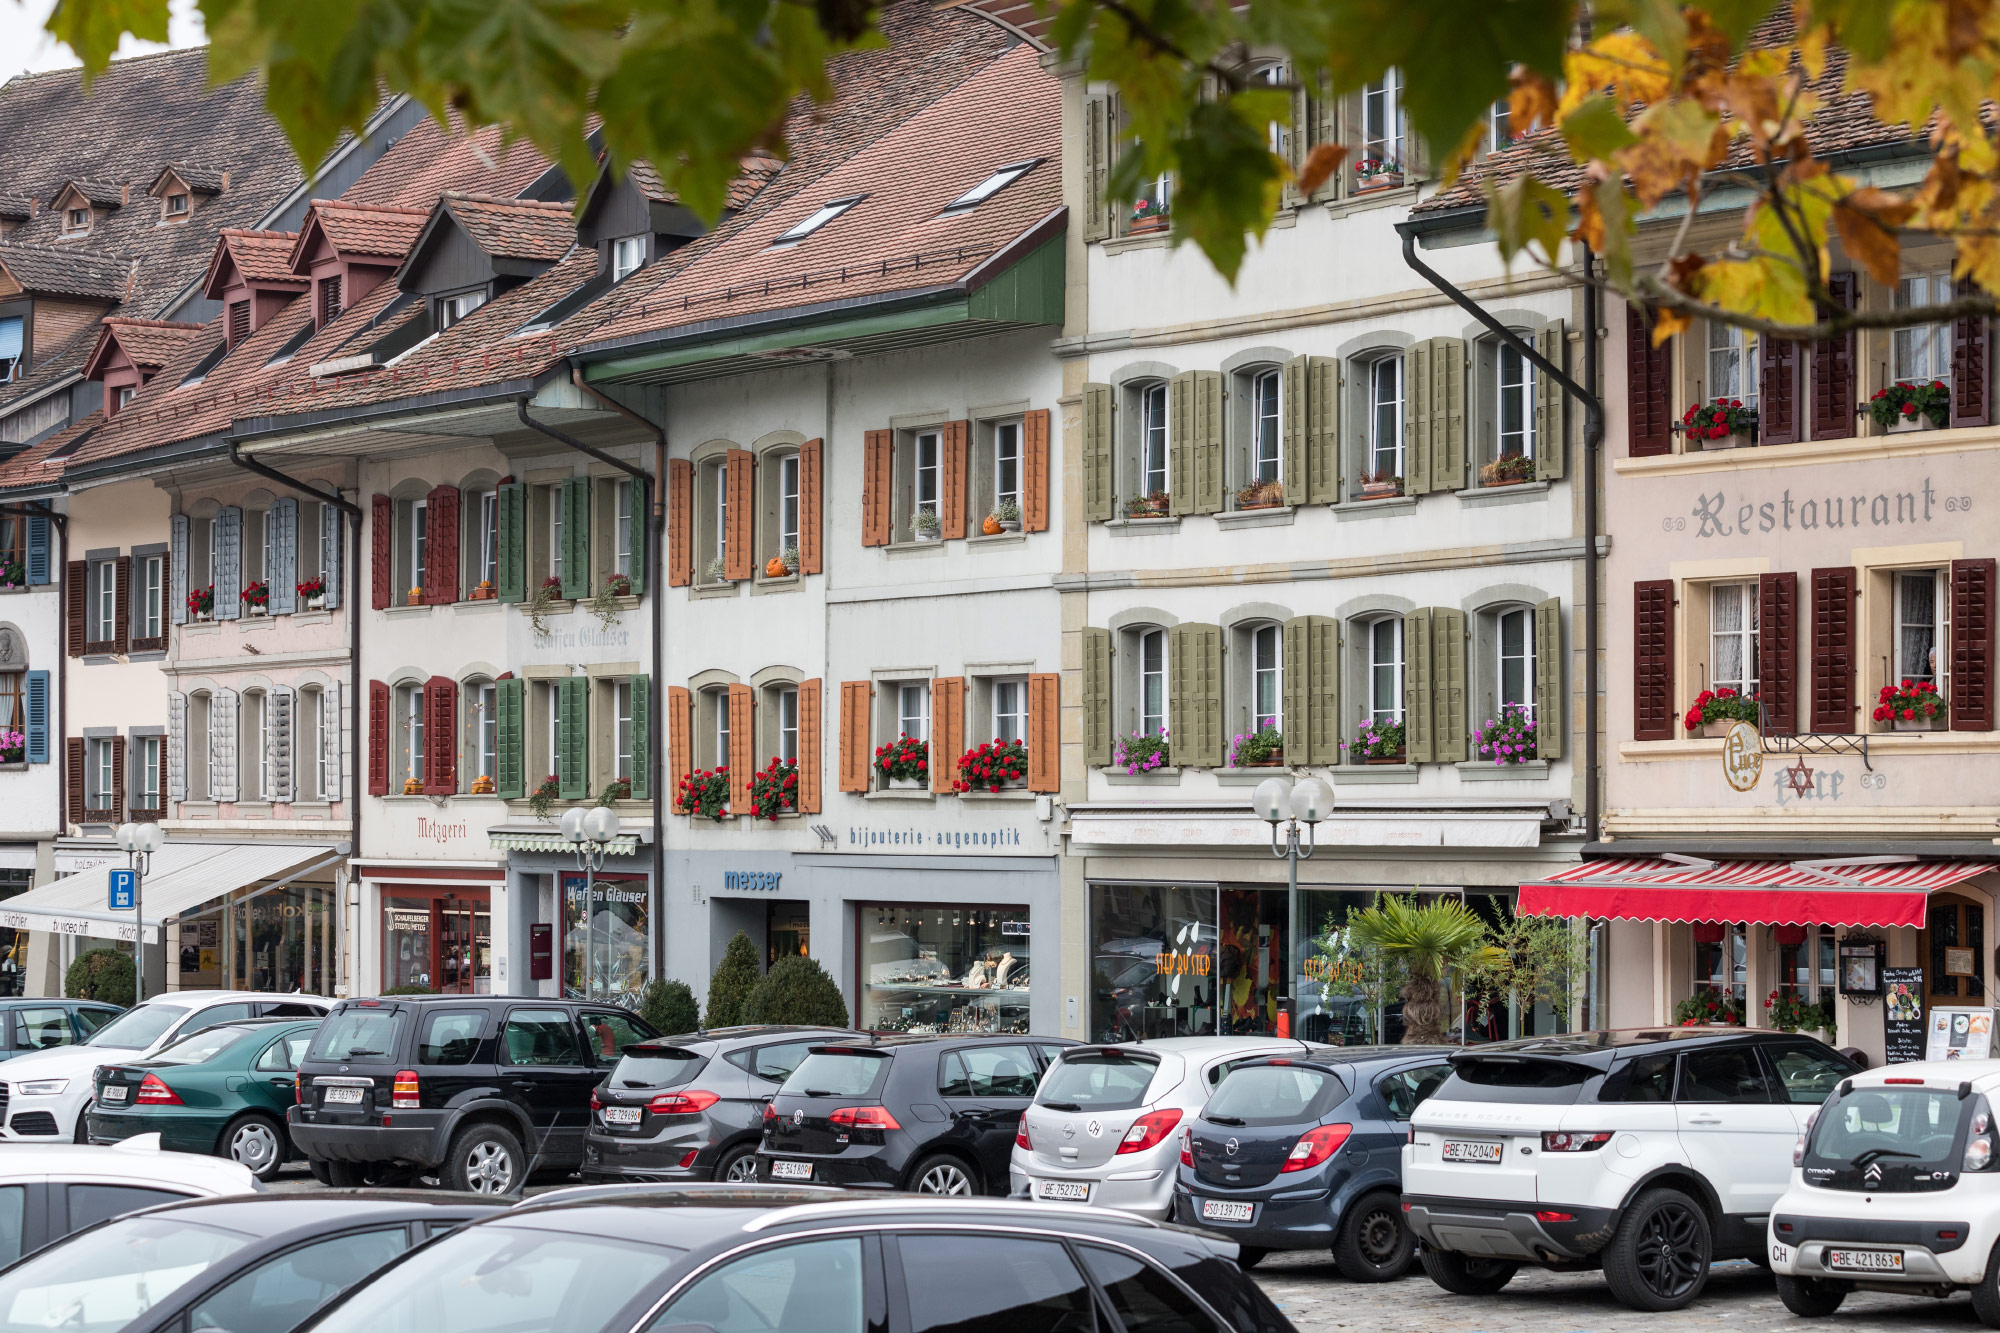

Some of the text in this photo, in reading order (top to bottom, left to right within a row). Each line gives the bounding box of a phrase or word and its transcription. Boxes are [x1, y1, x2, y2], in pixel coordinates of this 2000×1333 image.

[1692, 477, 1936, 538] Restaurant
[580, 626, 629, 648] Glauser
[417, 816, 467, 843] Metzgerei
[850, 827, 1020, 849] bijouterie augenoptik
[118, 874, 129, 891] P
[724, 871, 782, 890] messer
[606, 887, 647, 903] Glauser
[61, 920, 77, 933] video
[1156, 952, 1211, 978] STEP BY STEP
[1088, 1120, 1101, 1136] CH
[1772, 1246, 1787, 1263] CH
